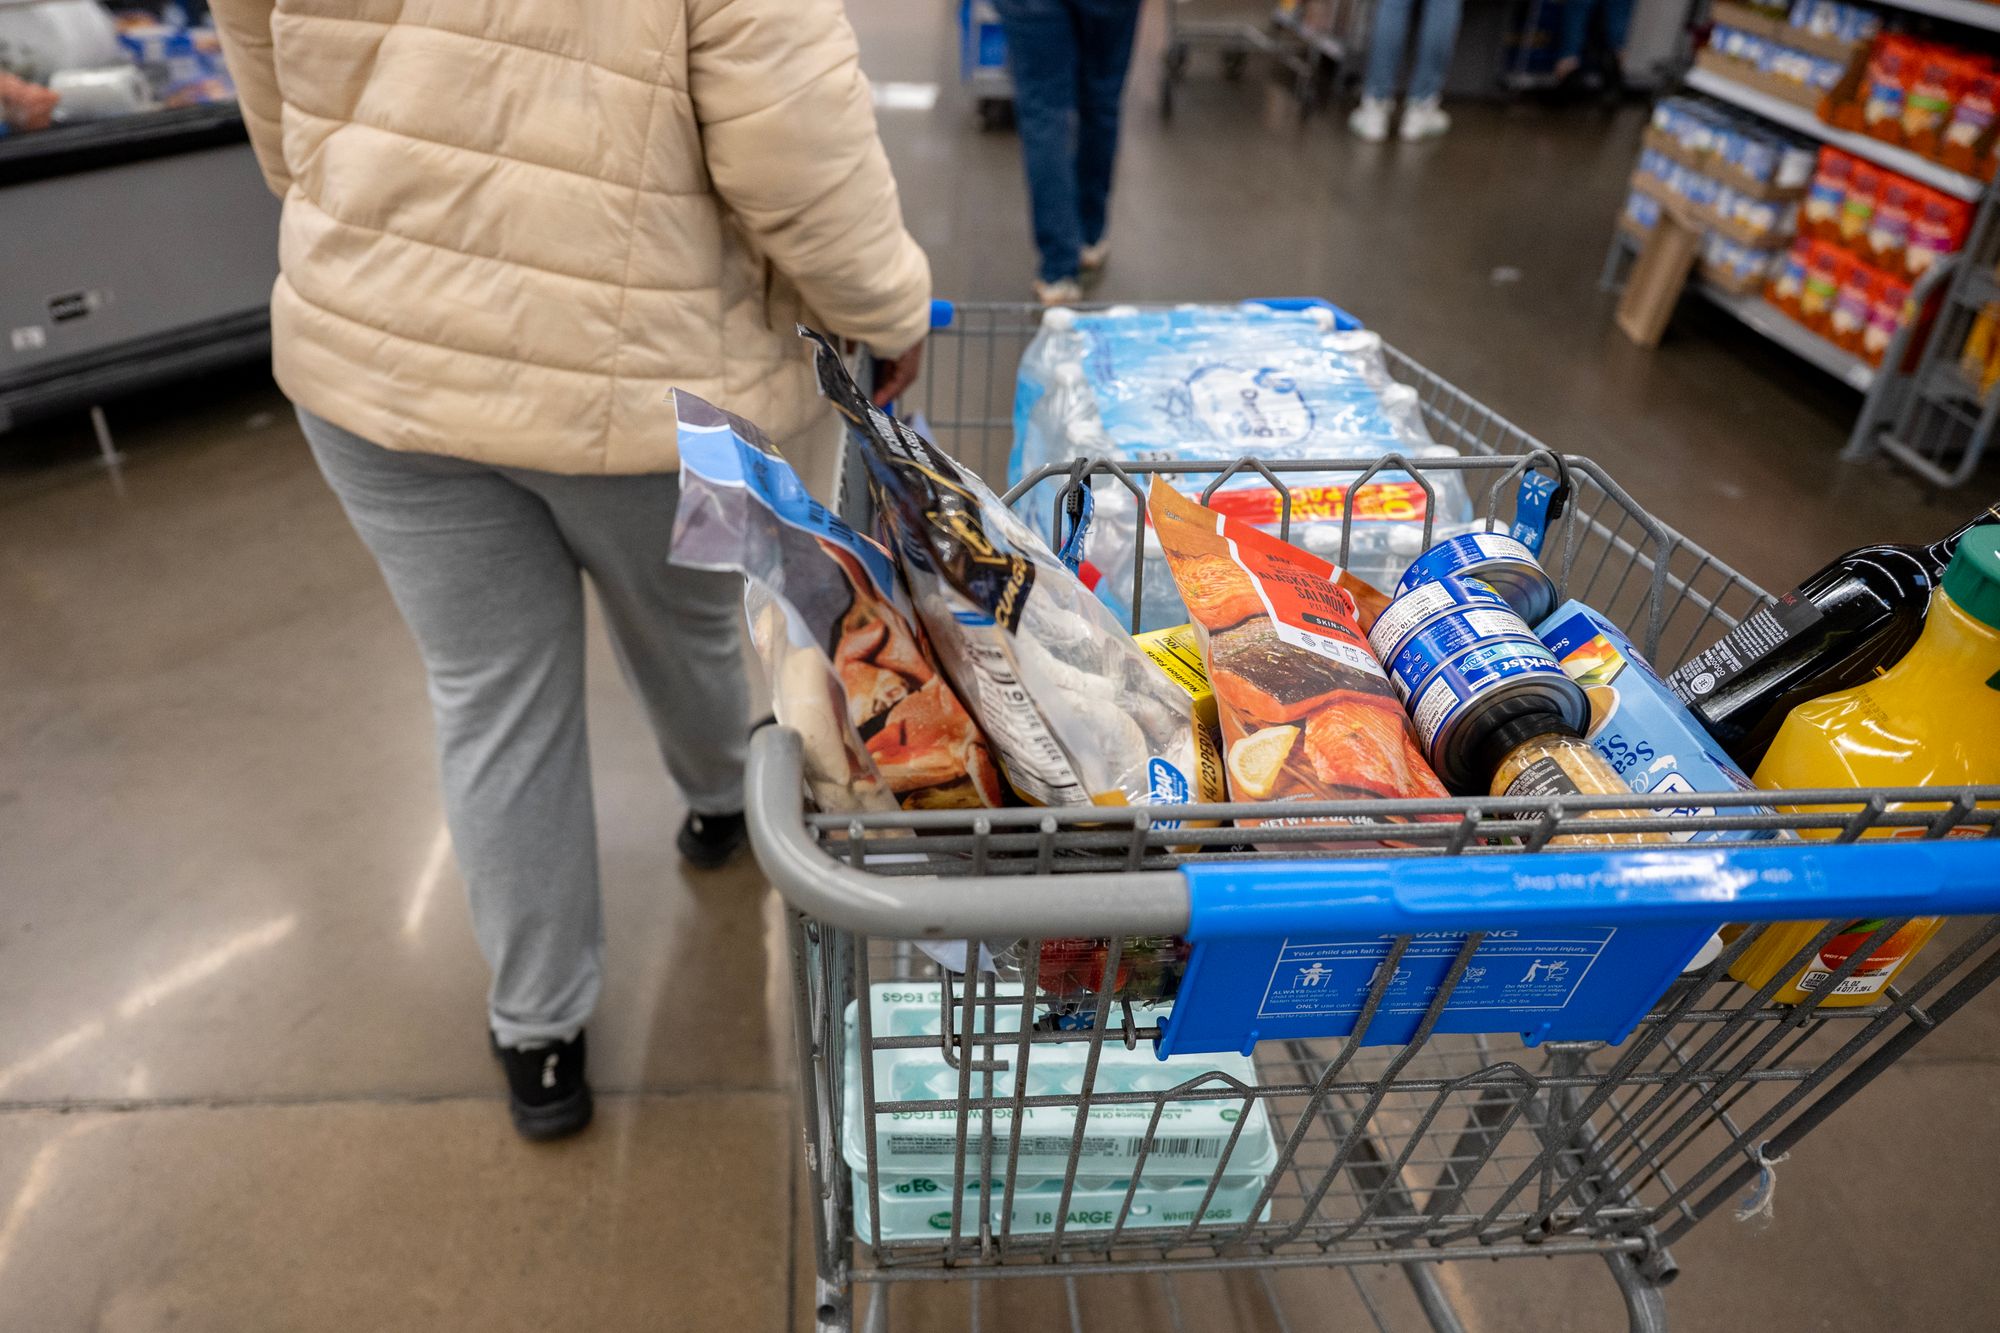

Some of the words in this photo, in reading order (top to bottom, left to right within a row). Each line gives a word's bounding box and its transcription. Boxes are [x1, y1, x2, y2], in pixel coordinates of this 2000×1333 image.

[1257, 570, 1312, 585] ALASKA
[1294, 586, 1346, 617] SALMON
[1316, 617, 1351, 635] SKIN-ON
[1400, 618, 1412, 629] 110
[1552, 637, 1570, 653] Sea
[1146, 650, 1167, 668] Facts
[1483, 649, 1493, 660] IN
[1460, 656, 1484, 673] WATER
[1501, 656, 1559, 673] tarKist
[1166, 666, 1200, 694] Nutrition
[1439, 697, 1457, 718] Nutrition
[1431, 716, 1441, 730] Facts
[1201, 738, 1215, 765] PER
[1154, 763, 1173, 803] BAP
[1201, 761, 1217, 803] 14/23
[1415, 930, 1518, 938] WARNNG
[882, 992, 923, 1003] EGGS
[892, 1111, 935, 1121] EGGS
[992, 1109, 1033, 1120] LRG
[1034, 1211, 1052, 1225] 18
[1062, 1211, 1113, 1225] ARGE
[1199, 1208, 1233, 1220] GGS
